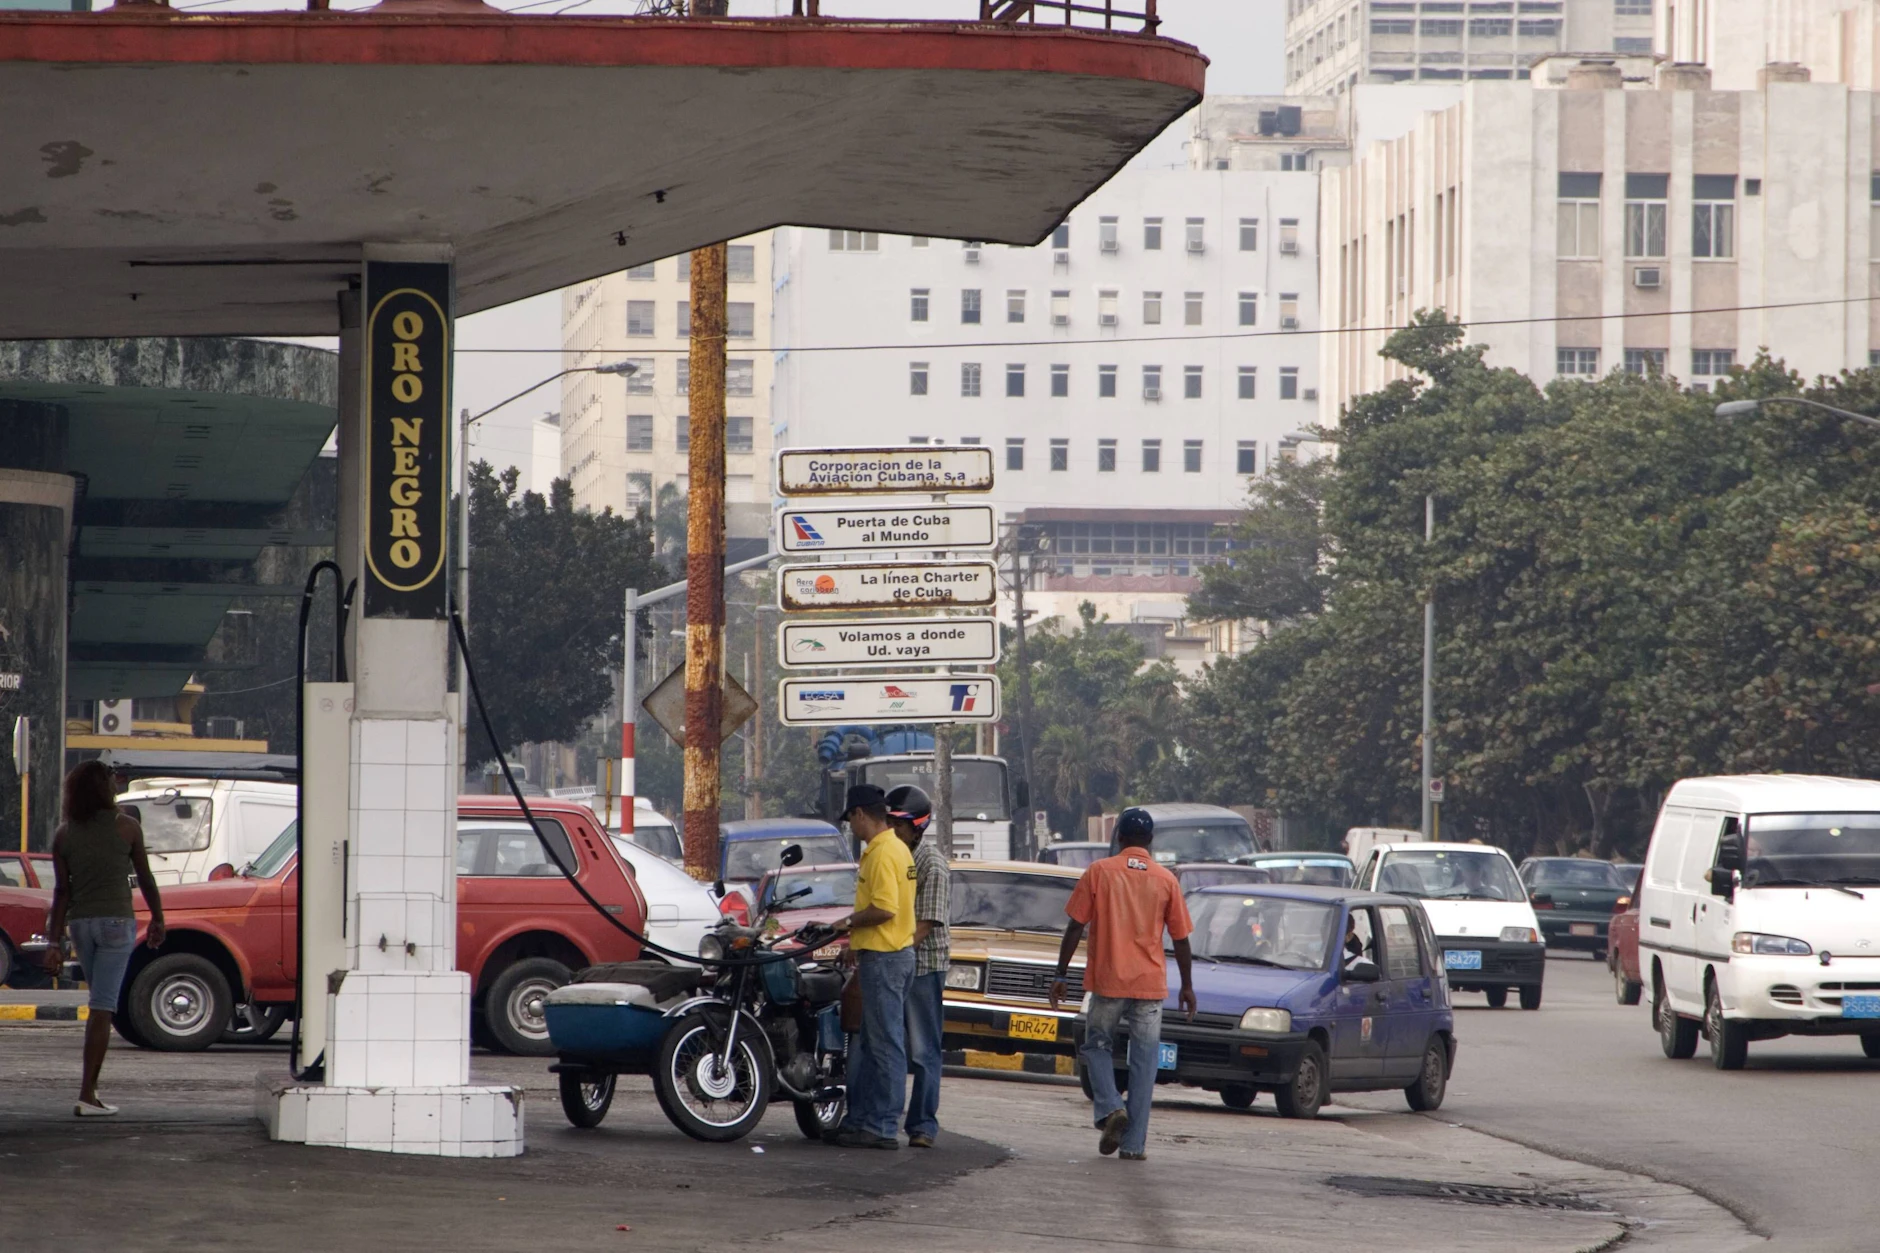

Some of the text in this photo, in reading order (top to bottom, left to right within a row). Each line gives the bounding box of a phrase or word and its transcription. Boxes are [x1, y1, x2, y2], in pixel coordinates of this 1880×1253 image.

[390, 311, 424, 569] ORO NEGRO
[809, 459, 942, 474] Corporacion de la
[809, 471, 873, 483] Aviación
[877, 471, 939, 483] Cubana,
[837, 515, 950, 528] Puerta de Cuba
[862, 530, 929, 542] al Mundo
[861, 571, 979, 584] La línea Charter
[893, 587, 952, 599] de Cuba
[839, 629, 965, 642] Volamos a donde
[867, 646, 930, 657] Ud. vaya
[1445, 955, 1479, 965] HSA277
[1010, 1020, 1056, 1036] HDR474
